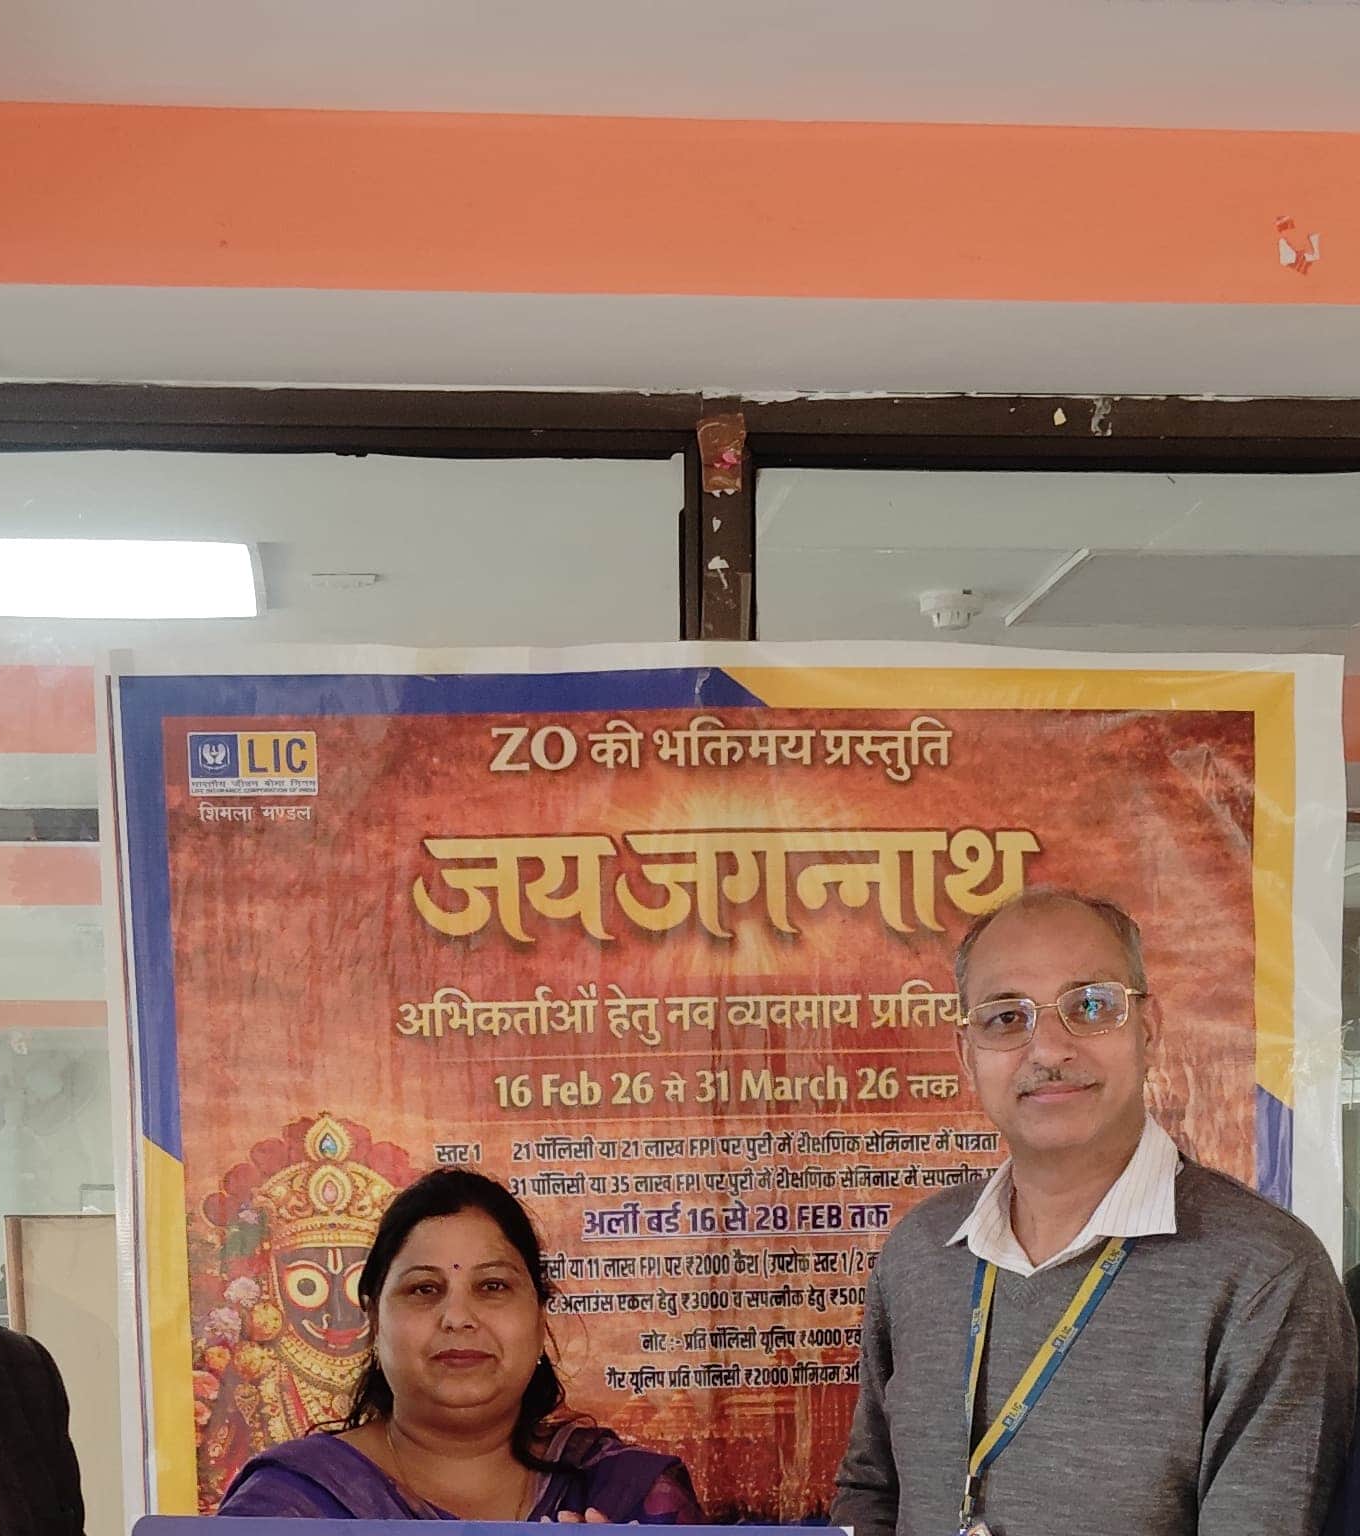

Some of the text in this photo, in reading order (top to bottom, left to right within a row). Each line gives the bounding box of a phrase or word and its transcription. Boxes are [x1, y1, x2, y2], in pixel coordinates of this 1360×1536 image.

[247, 738, 307, 773] LIC
[490, 726, 578, 771] ZO
[653, 716, 816, 767] भक्तिमय
[822, 716, 952, 781] प्रस्तुति
[198, 802, 312, 822] शिमला मण्डल
[412, 828, 1042, 943] जय जगन्नाथ
[396, 984, 597, 1037] अभिकर्ताओं
[607, 986, 660, 1045] हेतु
[666, 998, 717, 1031] नव
[495, 1067, 959, 1107] 16 Feb 26 से 31 March 26 तक
[436, 1143, 481, 1163] स्तर 1
[513, 1129, 999, 1161] 21 पॉलिसी या 21 लाख FPI पर पुरी में शैक्षणिक सेमिनार में पात्रता
[510, 1179, 526, 1196] 31
[531, 1173, 586, 1195] पॉलिसी
[590, 1177, 607, 1194] या
[611, 1176, 630, 1194] 35
[635, 1175, 672, 1193] लाख
[676, 1174, 700, 1193] FPI
[705, 1173, 725, 1189] पर
[729, 1168, 754, 1194] पुरी
[758, 1167, 773, 1189] में
[776, 1165, 837, 1189] शैक्षणिक
[840, 1166, 901, 1188] सेमिनार
[905, 1165, 921, 1186] में
[584, 1201, 890, 1234] अर्ली बर्ड 16 से 28 FEB तक
[642, 1333, 665, 1351] नोट
[685, 1328, 706, 1350] प्रति
[709, 1327, 756, 1349] पॉलिसी
[760, 1325, 795, 1354] यूलिप
[607, 1366, 625, 1388] गैर
[630, 1366, 664, 1393] यूलिप
[668, 1363, 690, 1387] प्रति
[693, 1363, 740, 1386] पॉलिसी
